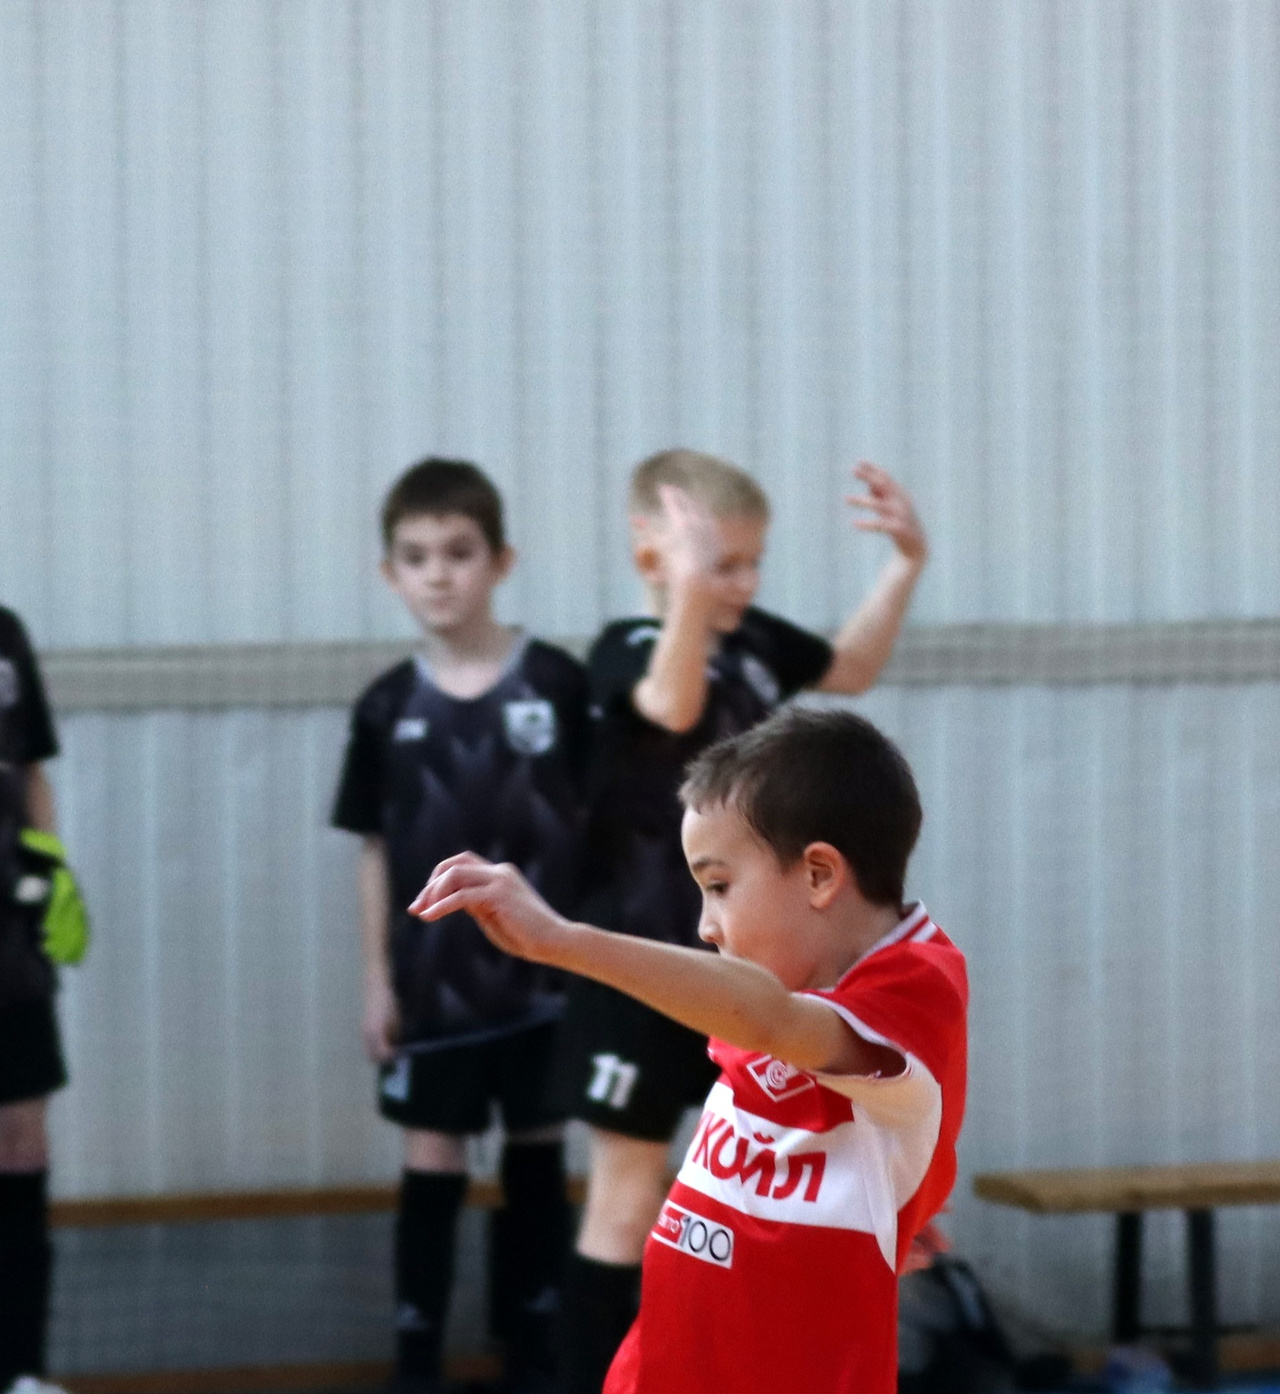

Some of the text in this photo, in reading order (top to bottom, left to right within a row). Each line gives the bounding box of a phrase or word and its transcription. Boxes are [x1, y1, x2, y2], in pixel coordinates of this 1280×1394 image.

[587, 1053, 639, 1108] 11
[691, 1110, 827, 1203] КОЙЛ
[678, 1213, 732, 1262] 100
